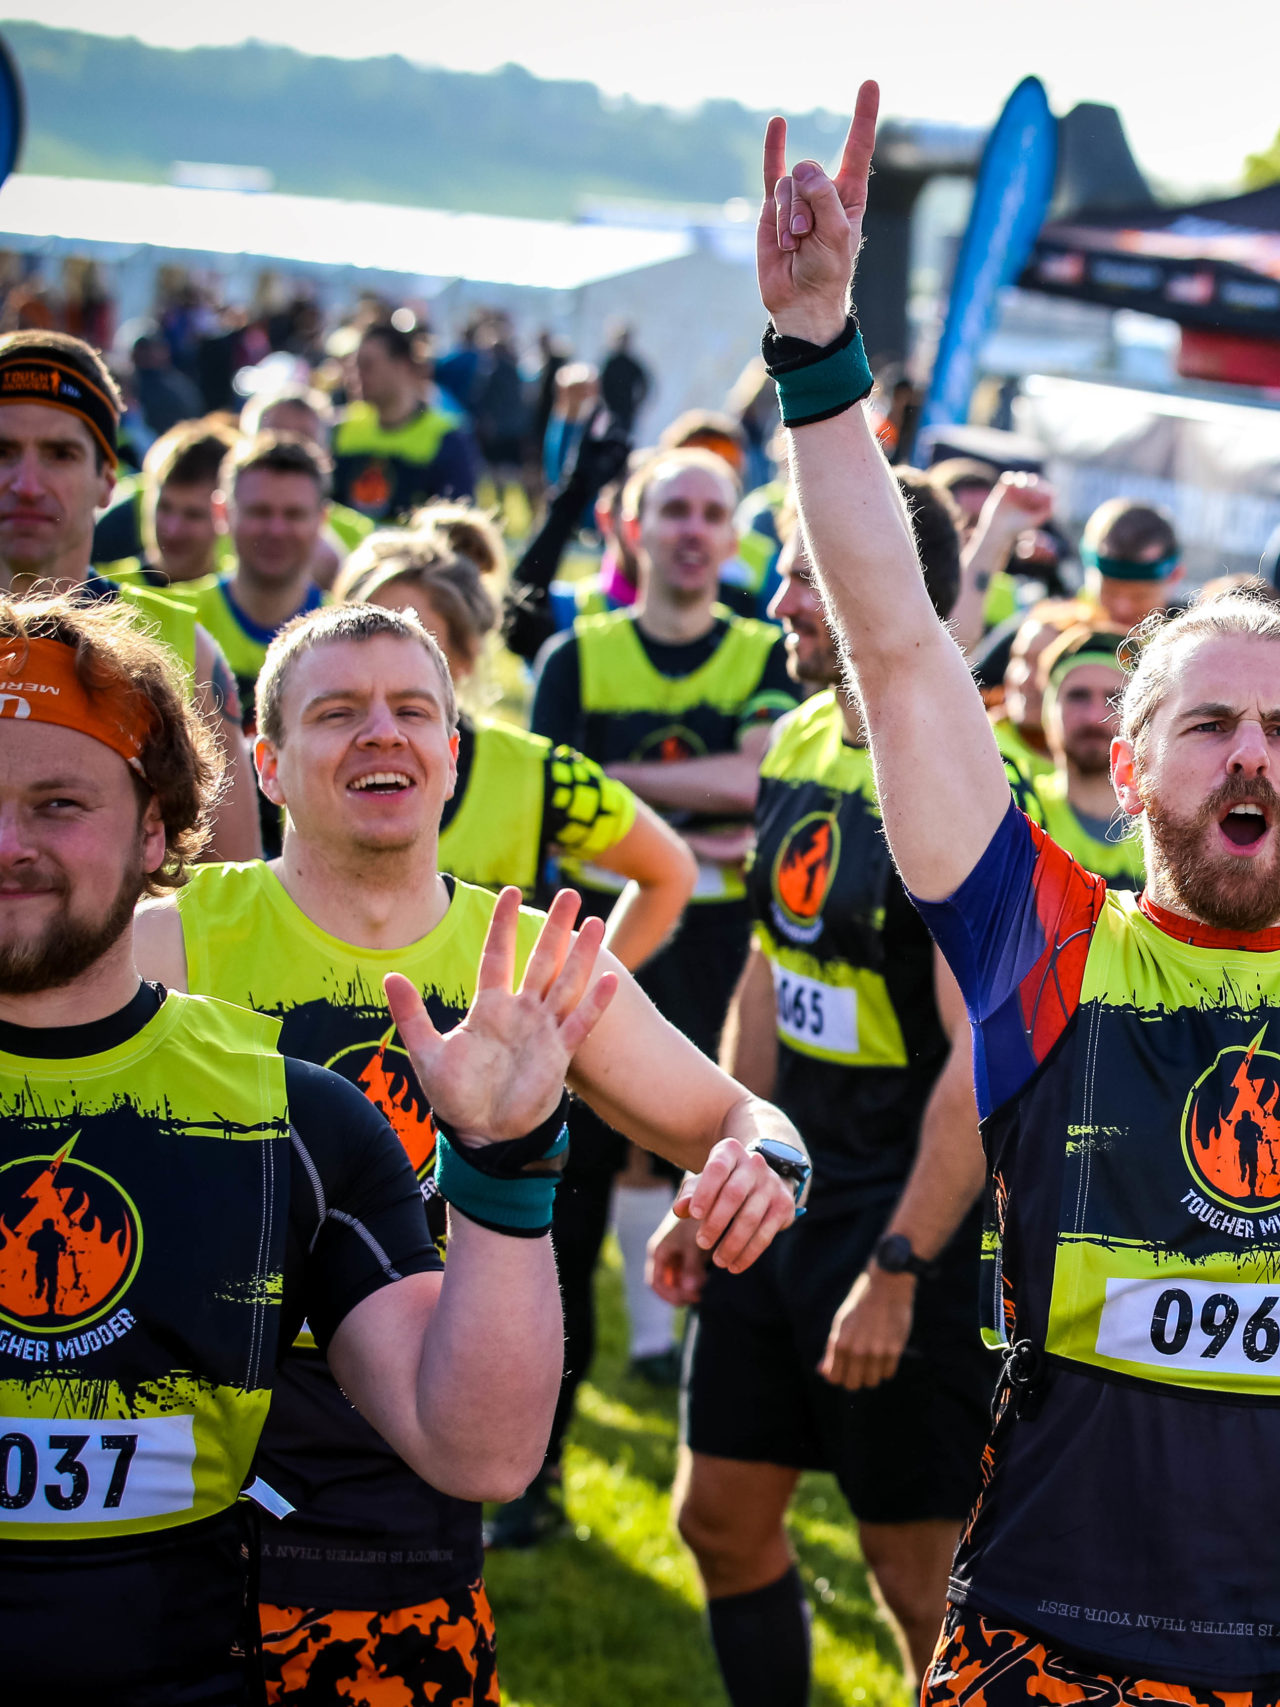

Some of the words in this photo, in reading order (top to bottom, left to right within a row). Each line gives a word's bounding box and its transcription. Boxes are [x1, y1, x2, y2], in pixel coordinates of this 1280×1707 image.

[1180, 1188, 1255, 1239] TOUGHER
[56, 1307, 137, 1362] MUDDER
[0, 1432, 138, 1510] 037
[276, 1546, 322, 1559] THAN
[325, 1550, 387, 1563] BETTER
[391, 1551, 403, 1563] IS
[1037, 1600, 1081, 1618] BEST
[1085, 1609, 1132, 1627] YOUR
[1137, 1613, 1187, 1632] THAN
[1192, 1620, 1255, 1636] BETTER
[1258, 1624, 1273, 1636] IS
